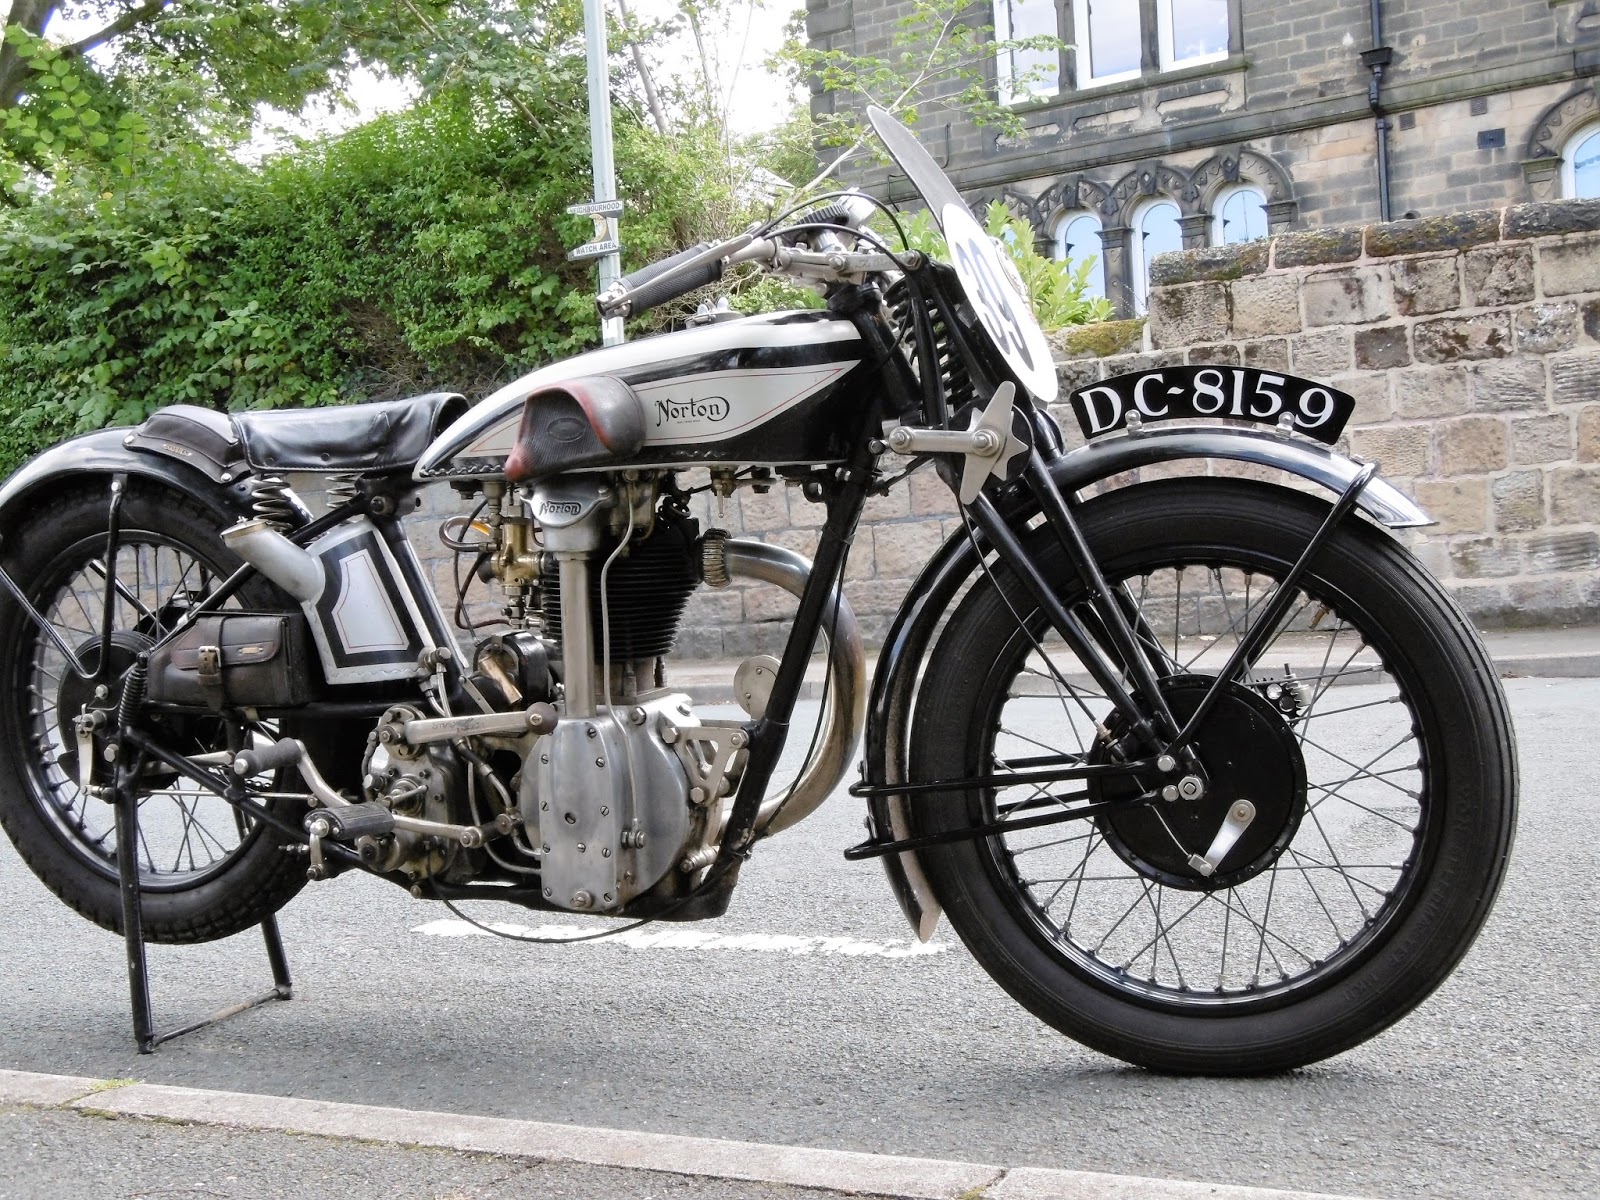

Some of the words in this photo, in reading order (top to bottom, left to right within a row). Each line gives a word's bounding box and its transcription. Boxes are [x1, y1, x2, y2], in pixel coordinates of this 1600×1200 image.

[576, 244, 598, 255] WATCH
[599, 241, 617, 251] AREA
[654, 395, 730, 427] Norton
[539, 500, 582, 516] Norton
